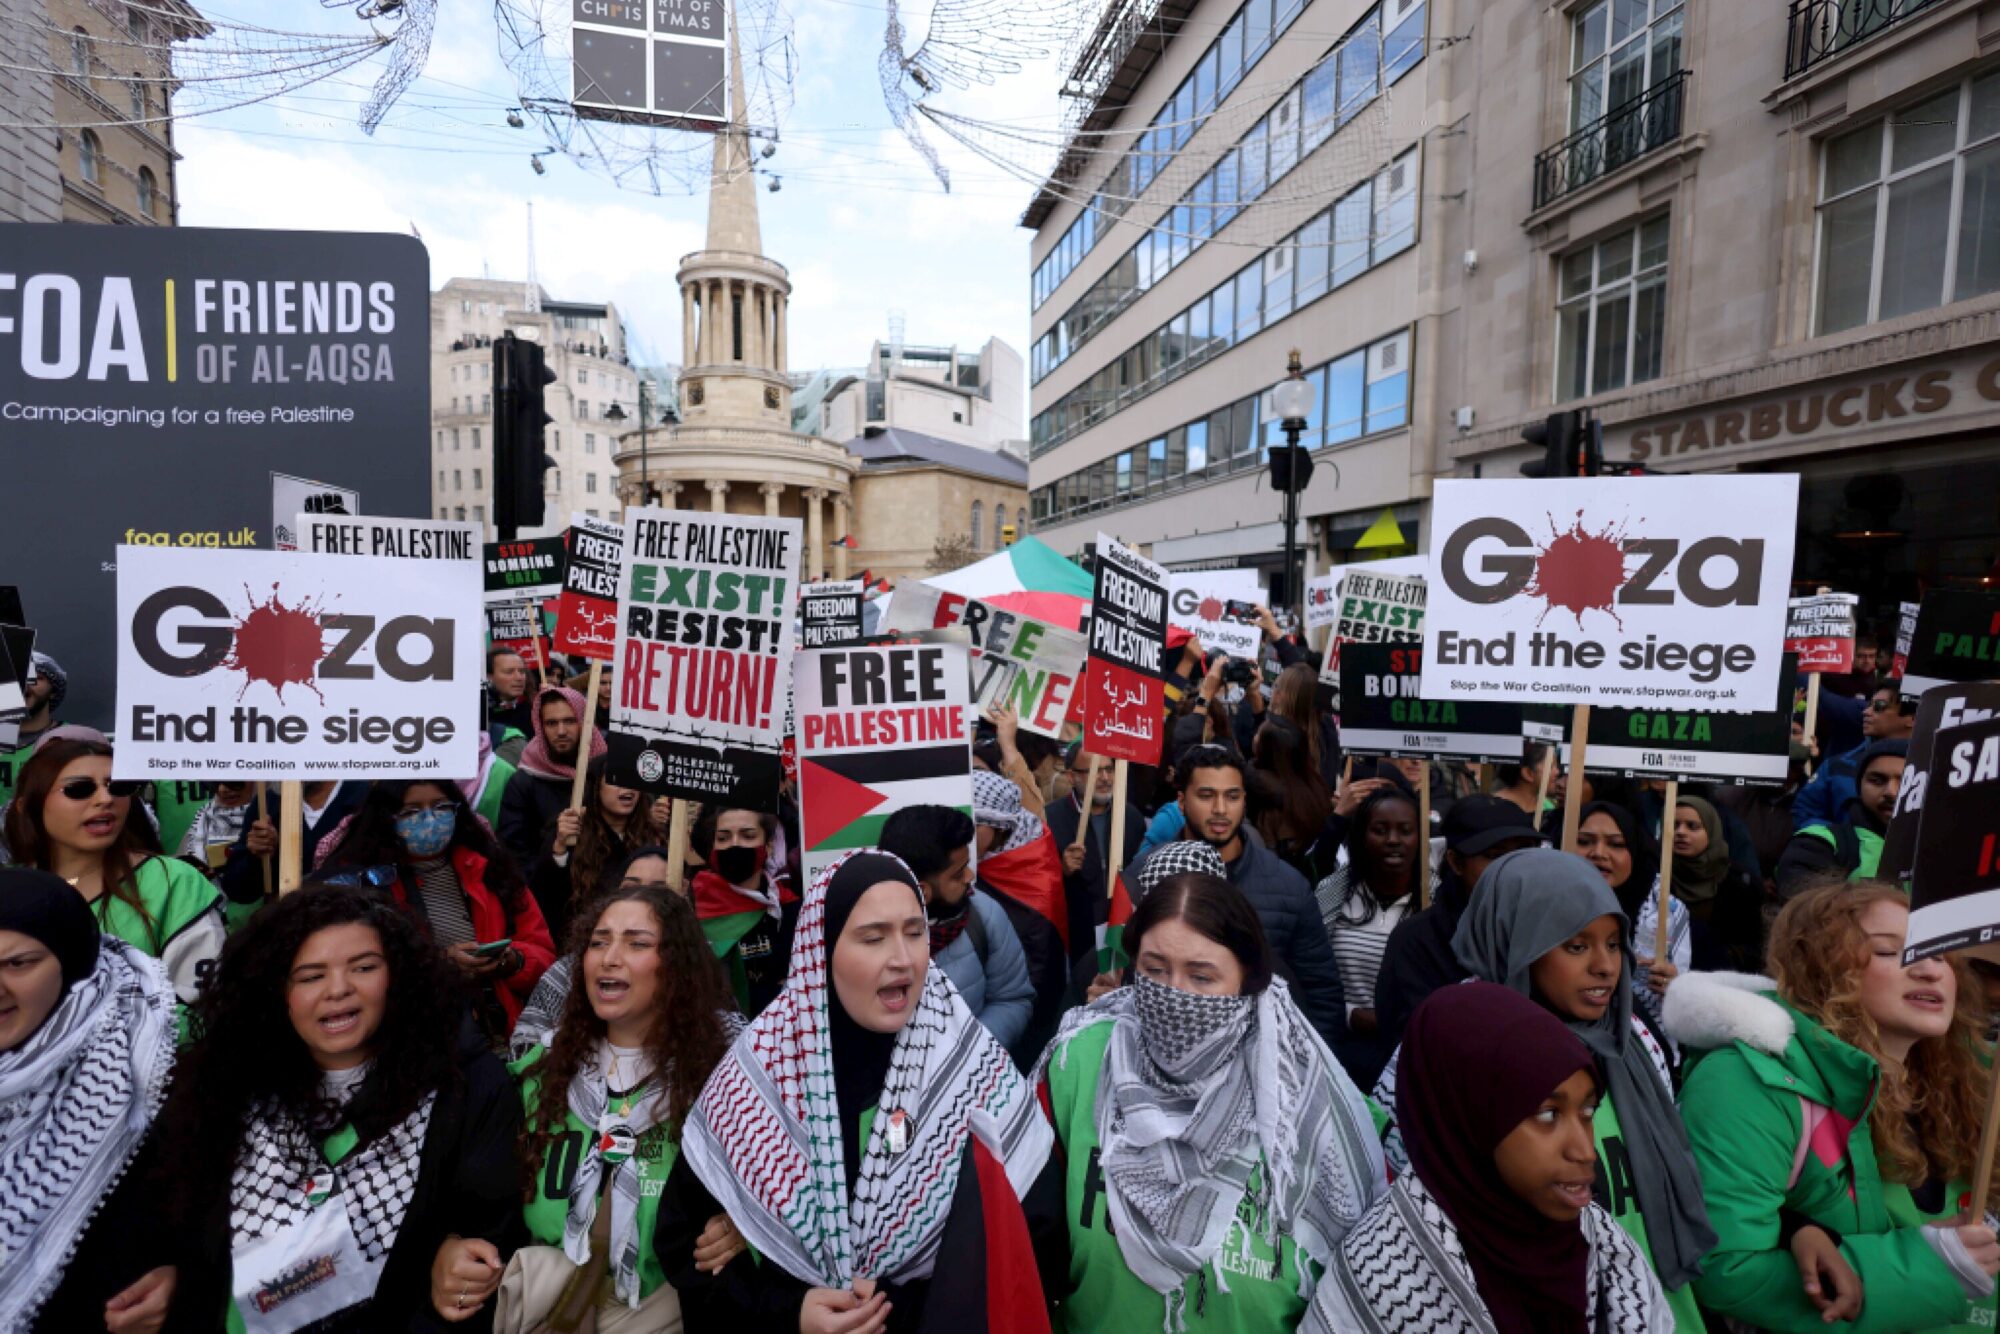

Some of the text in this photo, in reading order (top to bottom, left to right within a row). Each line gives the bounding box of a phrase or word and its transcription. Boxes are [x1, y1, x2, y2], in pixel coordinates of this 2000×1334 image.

[194, 279, 396, 335] FRIENDS
[196, 343, 395, 385] OF AL-AQSA
[2, 402, 354, 428] Campaigning for a free Palestine
[1629, 370, 1953, 462] STARBUCKS
[312, 523, 473, 560] FREE PALESTINE
[498, 543, 535, 558] STOP
[576, 533, 622, 563] FREED
[633, 519, 790, 570] FREE PALESTINE
[487, 554, 554, 573] BOMBING
[1441, 516, 1765, 607] Gza
[505, 570, 541, 584] GAZA
[568, 566, 620, 599] PALEST
[630, 563, 786, 617] EXIST!
[1347, 574, 1373, 596] FREE
[806, 598, 857, 617] FREEDOM
[1101, 566, 1162, 624] FREEDOM
[1793, 604, 1850, 620] FREEDOM
[131, 585, 456, 683] Gza
[494, 624, 543, 640] PALESTIE
[627, 605, 782, 654] RESIST!
[804, 625, 860, 645] PALESTINE
[933, 591, 1045, 661] FREE
[1787, 622, 1852, 637] PALESTINE
[1093, 616, 1162, 673] PALESTINE
[1437, 630, 1756, 683] End the siege
[620, 638, 778, 729] RETURN!
[820, 648, 946, 707] FREE
[1450, 679, 1592, 694] Stop the War Coalition
[1600, 685, 1737, 700] www.stopwar.org.uk
[1391, 701, 1458, 724] GAZA
[132, 705, 456, 754] End the siege
[804, 705, 965, 750] PALESTINE
[1628, 713, 1712, 741] GAZA
[1403, 735, 1421, 747] FOA
[148, 757, 296, 771] Stop the War Coalition
[304, 758, 440, 771] www.stopwar.org.uk
[668, 754, 734, 774] PALESTINE
[1642, 752, 1663, 766] FOA
[666, 775, 730, 794] CAMPAIGN
[667, 765, 741, 786] SOLIDARITY
